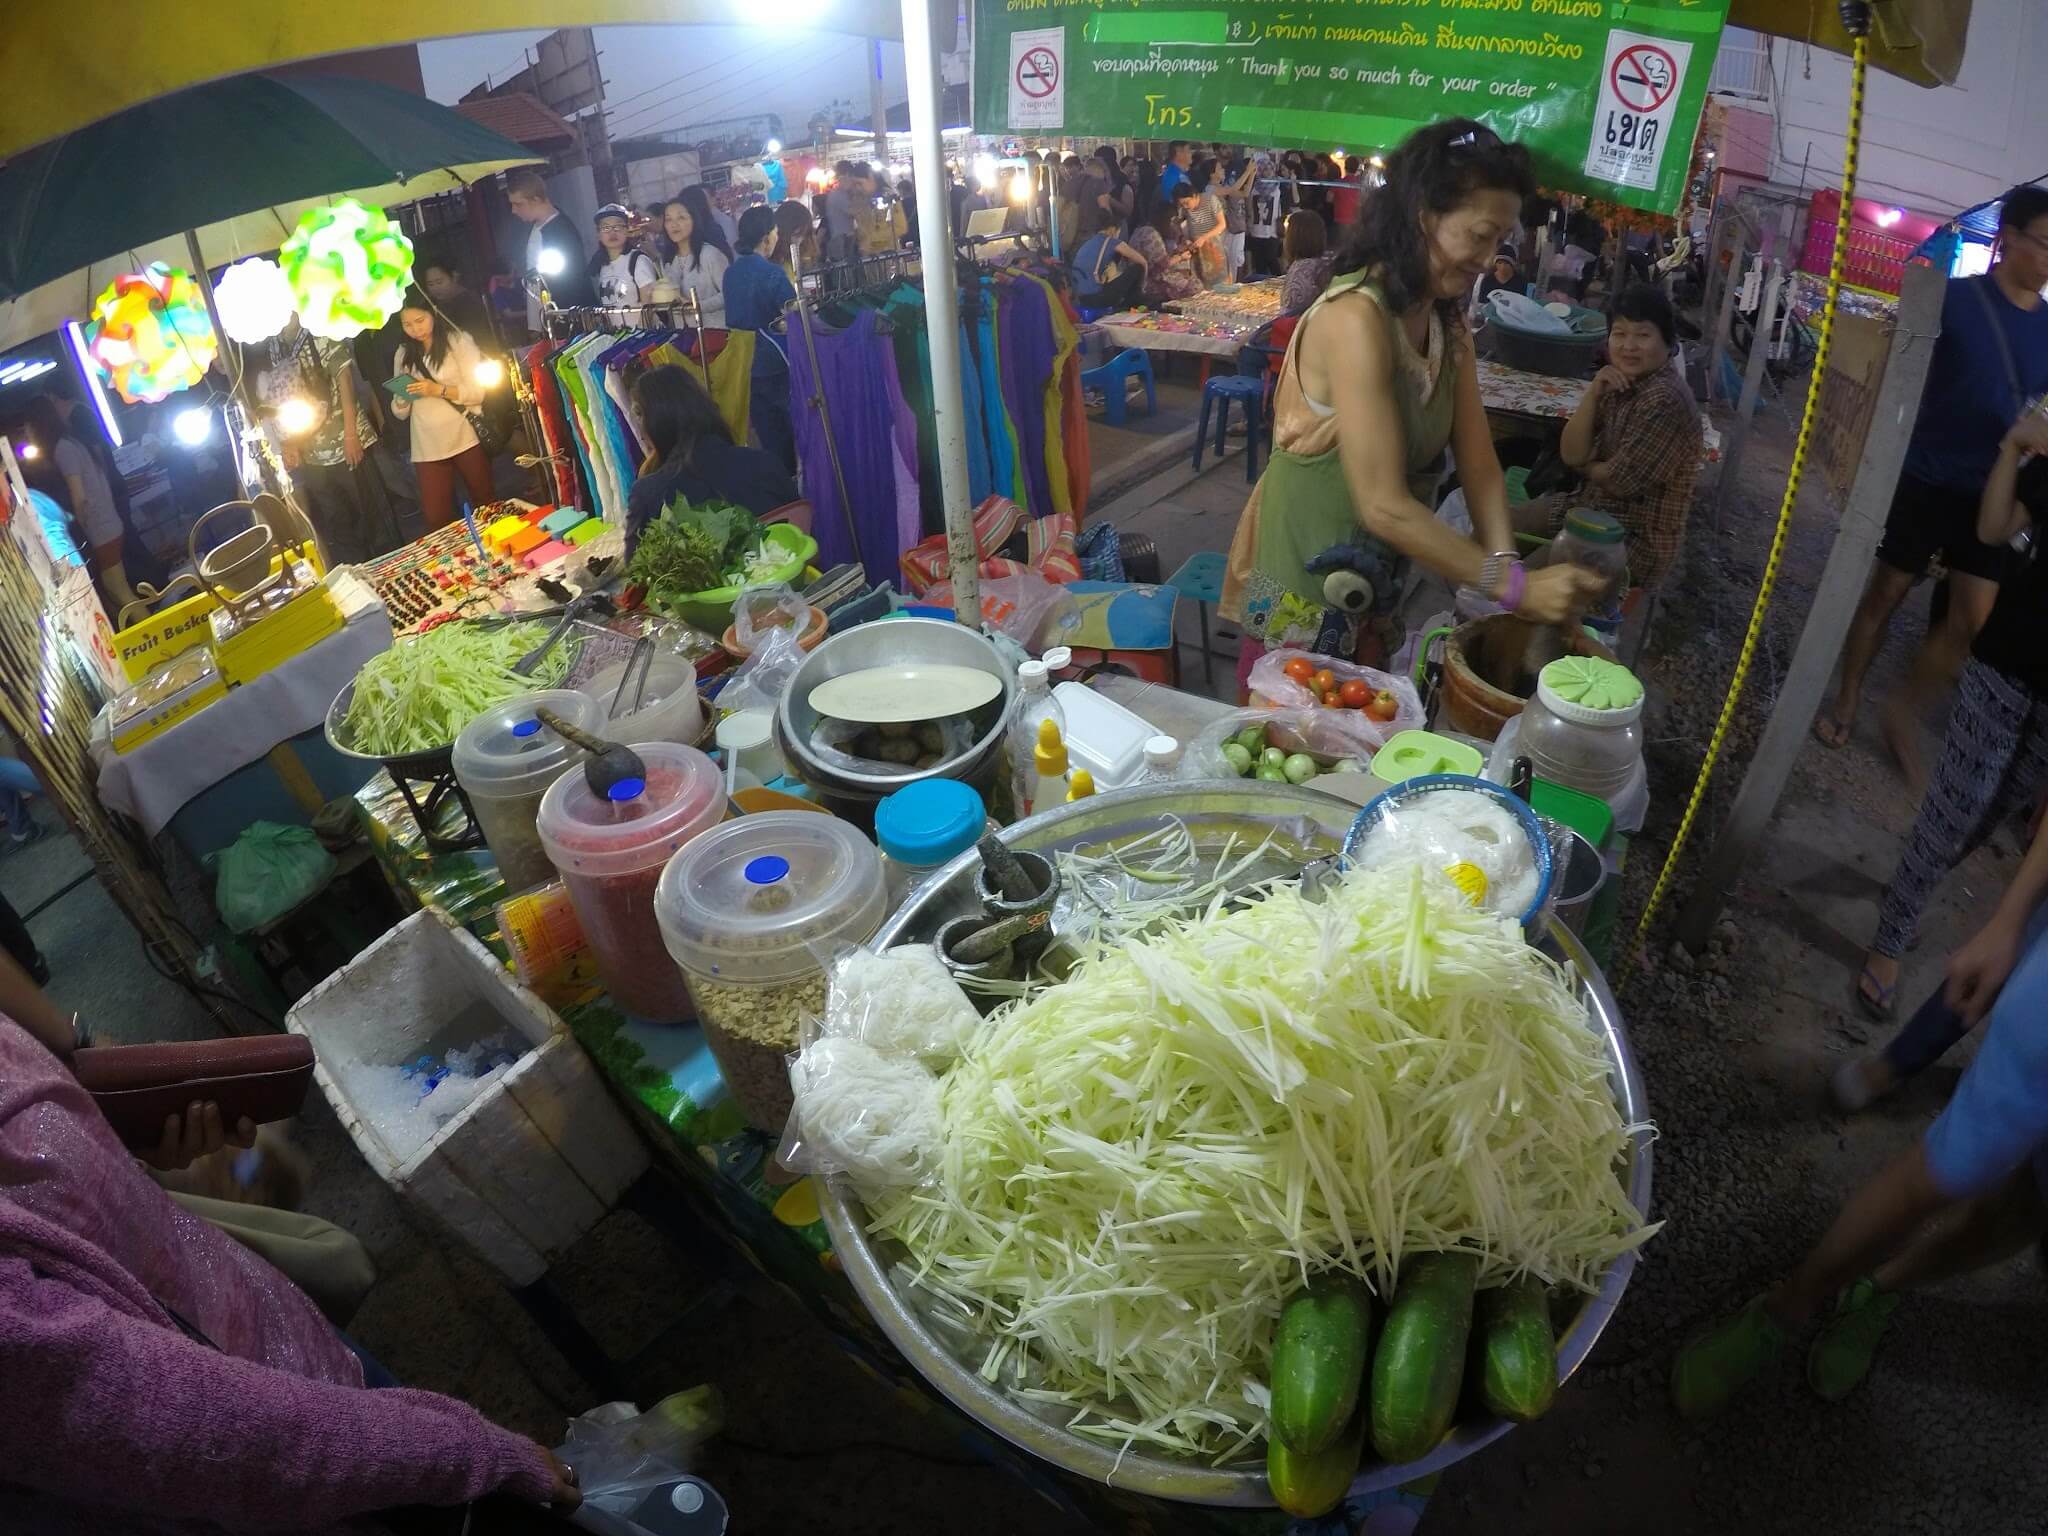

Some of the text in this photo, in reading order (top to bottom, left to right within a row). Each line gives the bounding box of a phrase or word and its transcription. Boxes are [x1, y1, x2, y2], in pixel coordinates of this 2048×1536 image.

[1324, 21, 1429, 46] ถนนคนเดิน
[1436, 19, 1585, 60] สี่แยกกลางเวียง
[1093, 46, 1219, 79] ขอบคุณที่อุดหนุน
[1241, 57, 1288, 76] Thank
[1294, 64, 1320, 82] you
[1329, 67, 1349, 81] so
[1356, 65, 1401, 85] much
[1408, 68, 1435, 87] for
[1442, 77, 1482, 94] your
[1489, 79, 1537, 98] order
[1145, 94, 1202, 128] โทร.
[1605, 110, 1659, 151] เขต
[122, 633, 159, 661] Fruit
